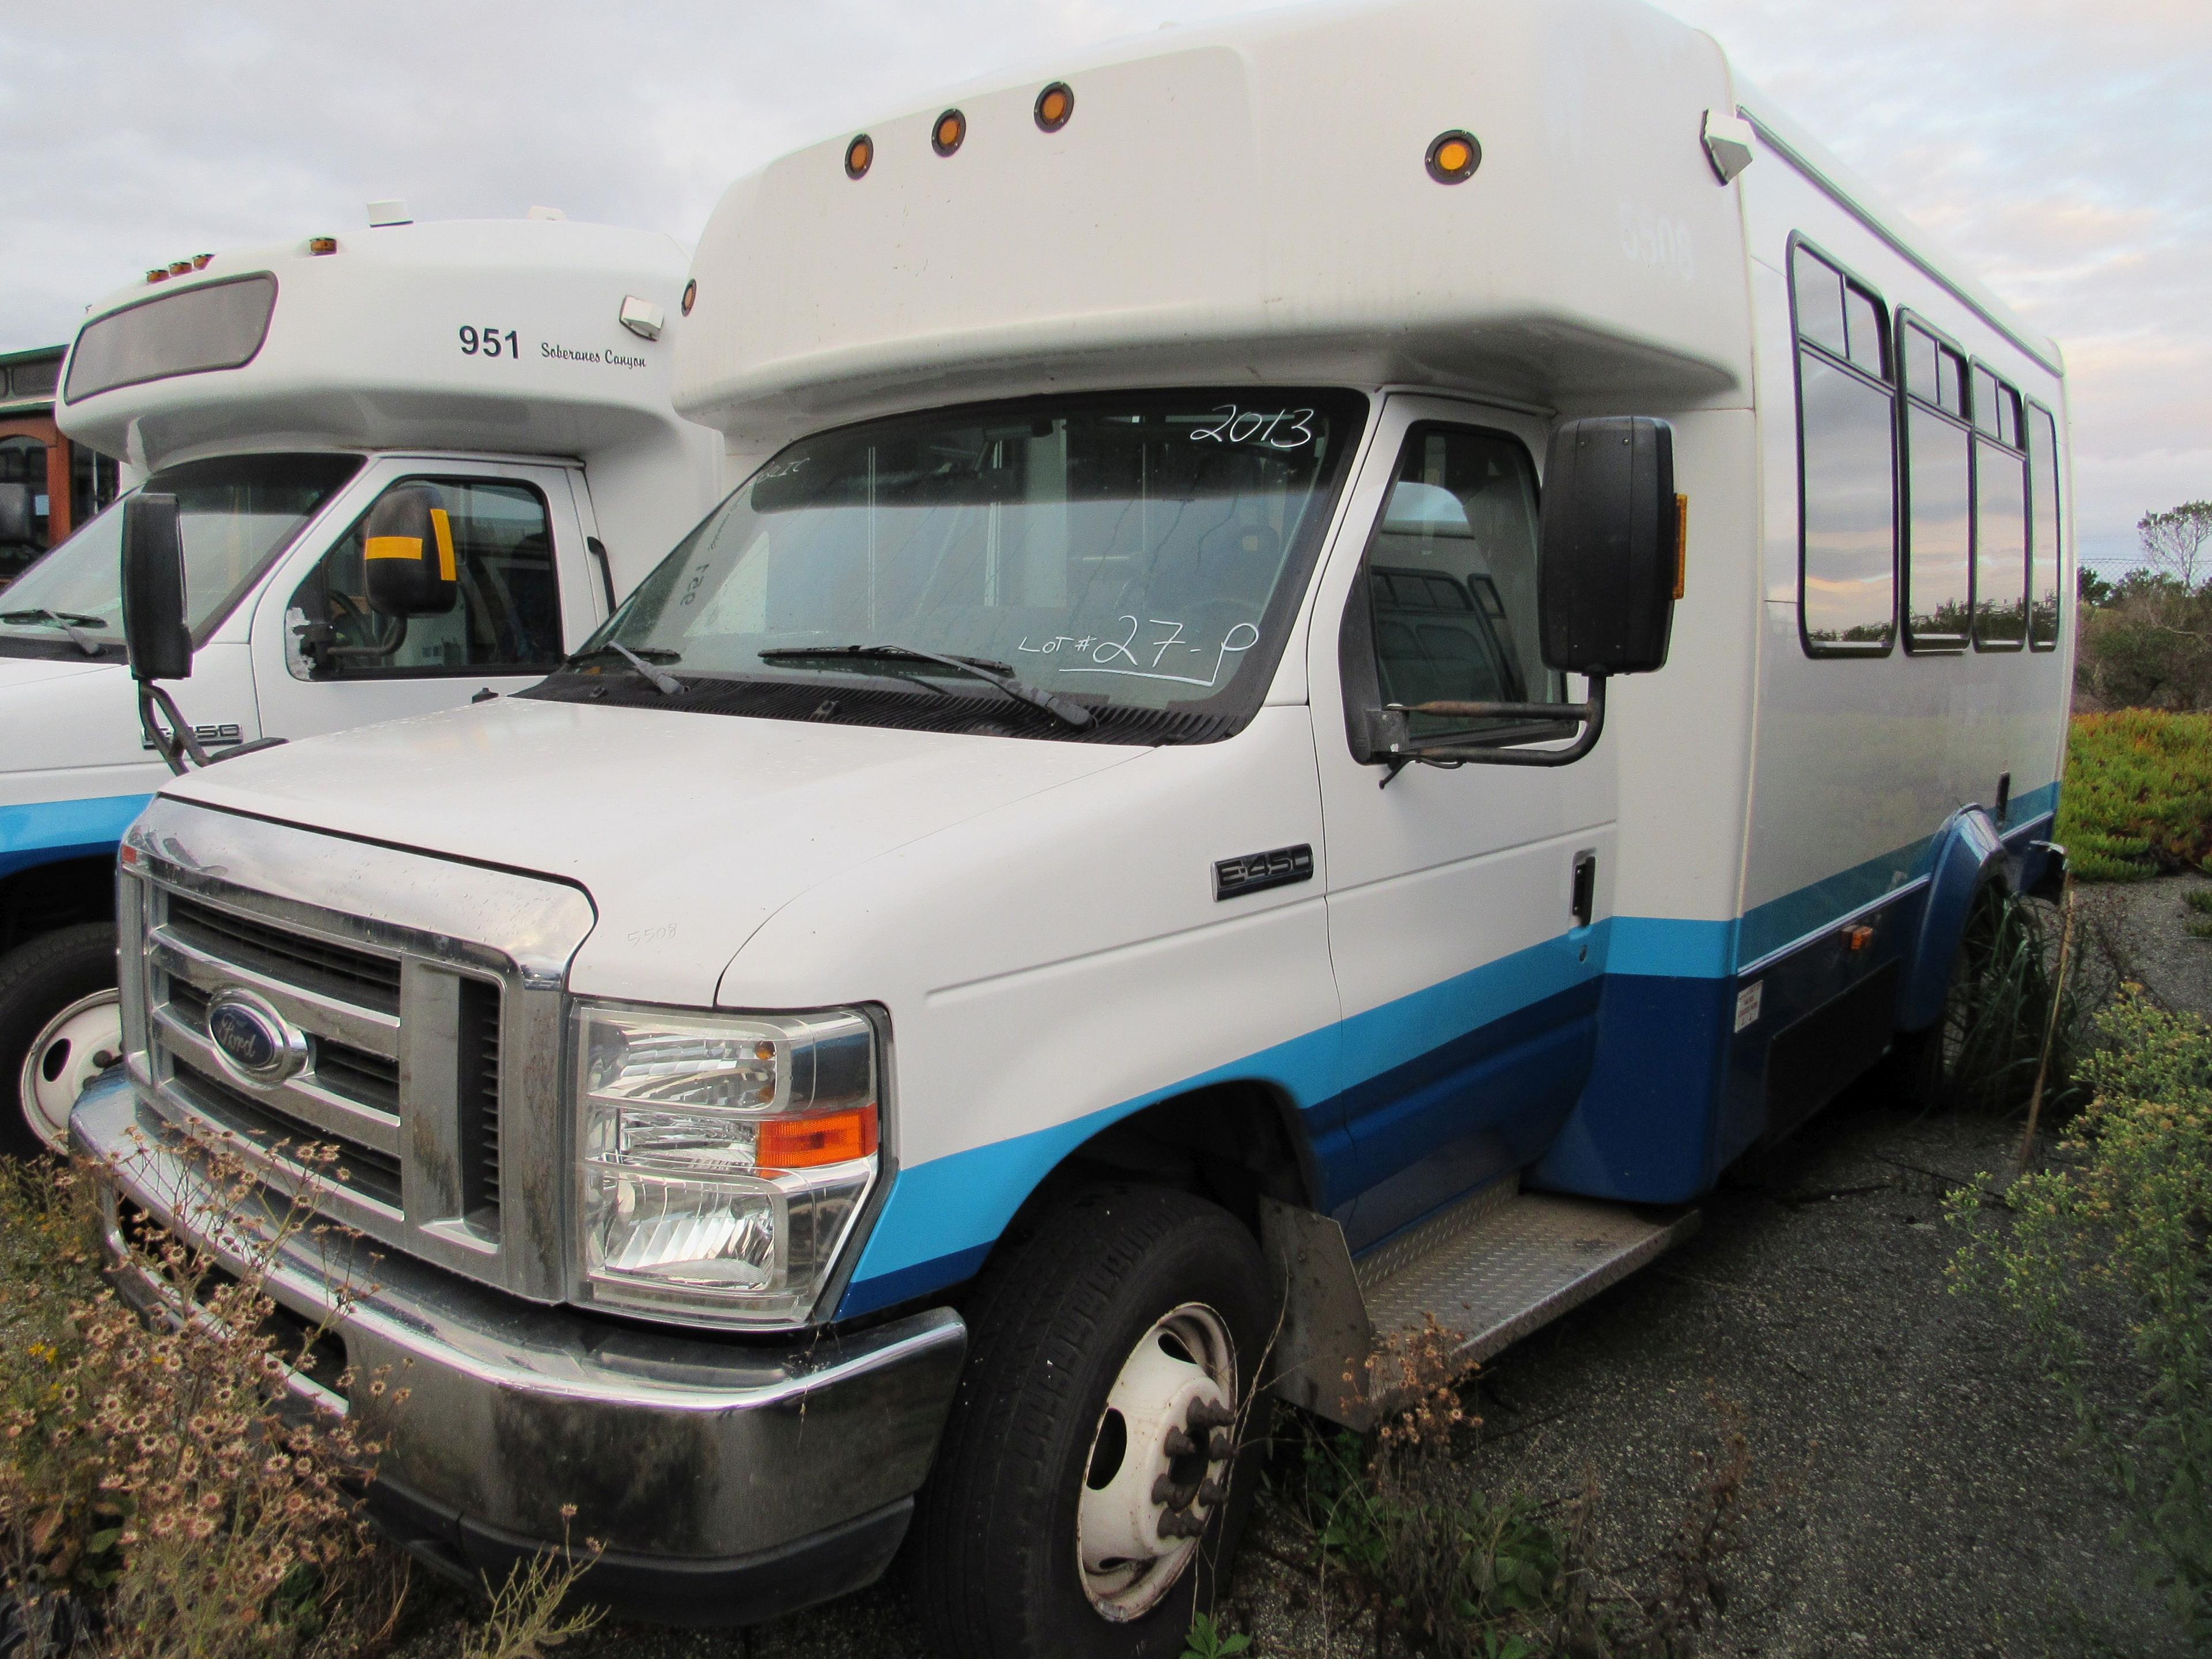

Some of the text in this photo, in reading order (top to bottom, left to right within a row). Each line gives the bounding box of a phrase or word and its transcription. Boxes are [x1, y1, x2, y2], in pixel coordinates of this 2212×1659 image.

[459, 325, 519, 359] 951
[541, 342, 647, 369] Soberanes Canyon
[1190, 404, 1314, 448] 2013
[219, 1016, 256, 1058] Ford
